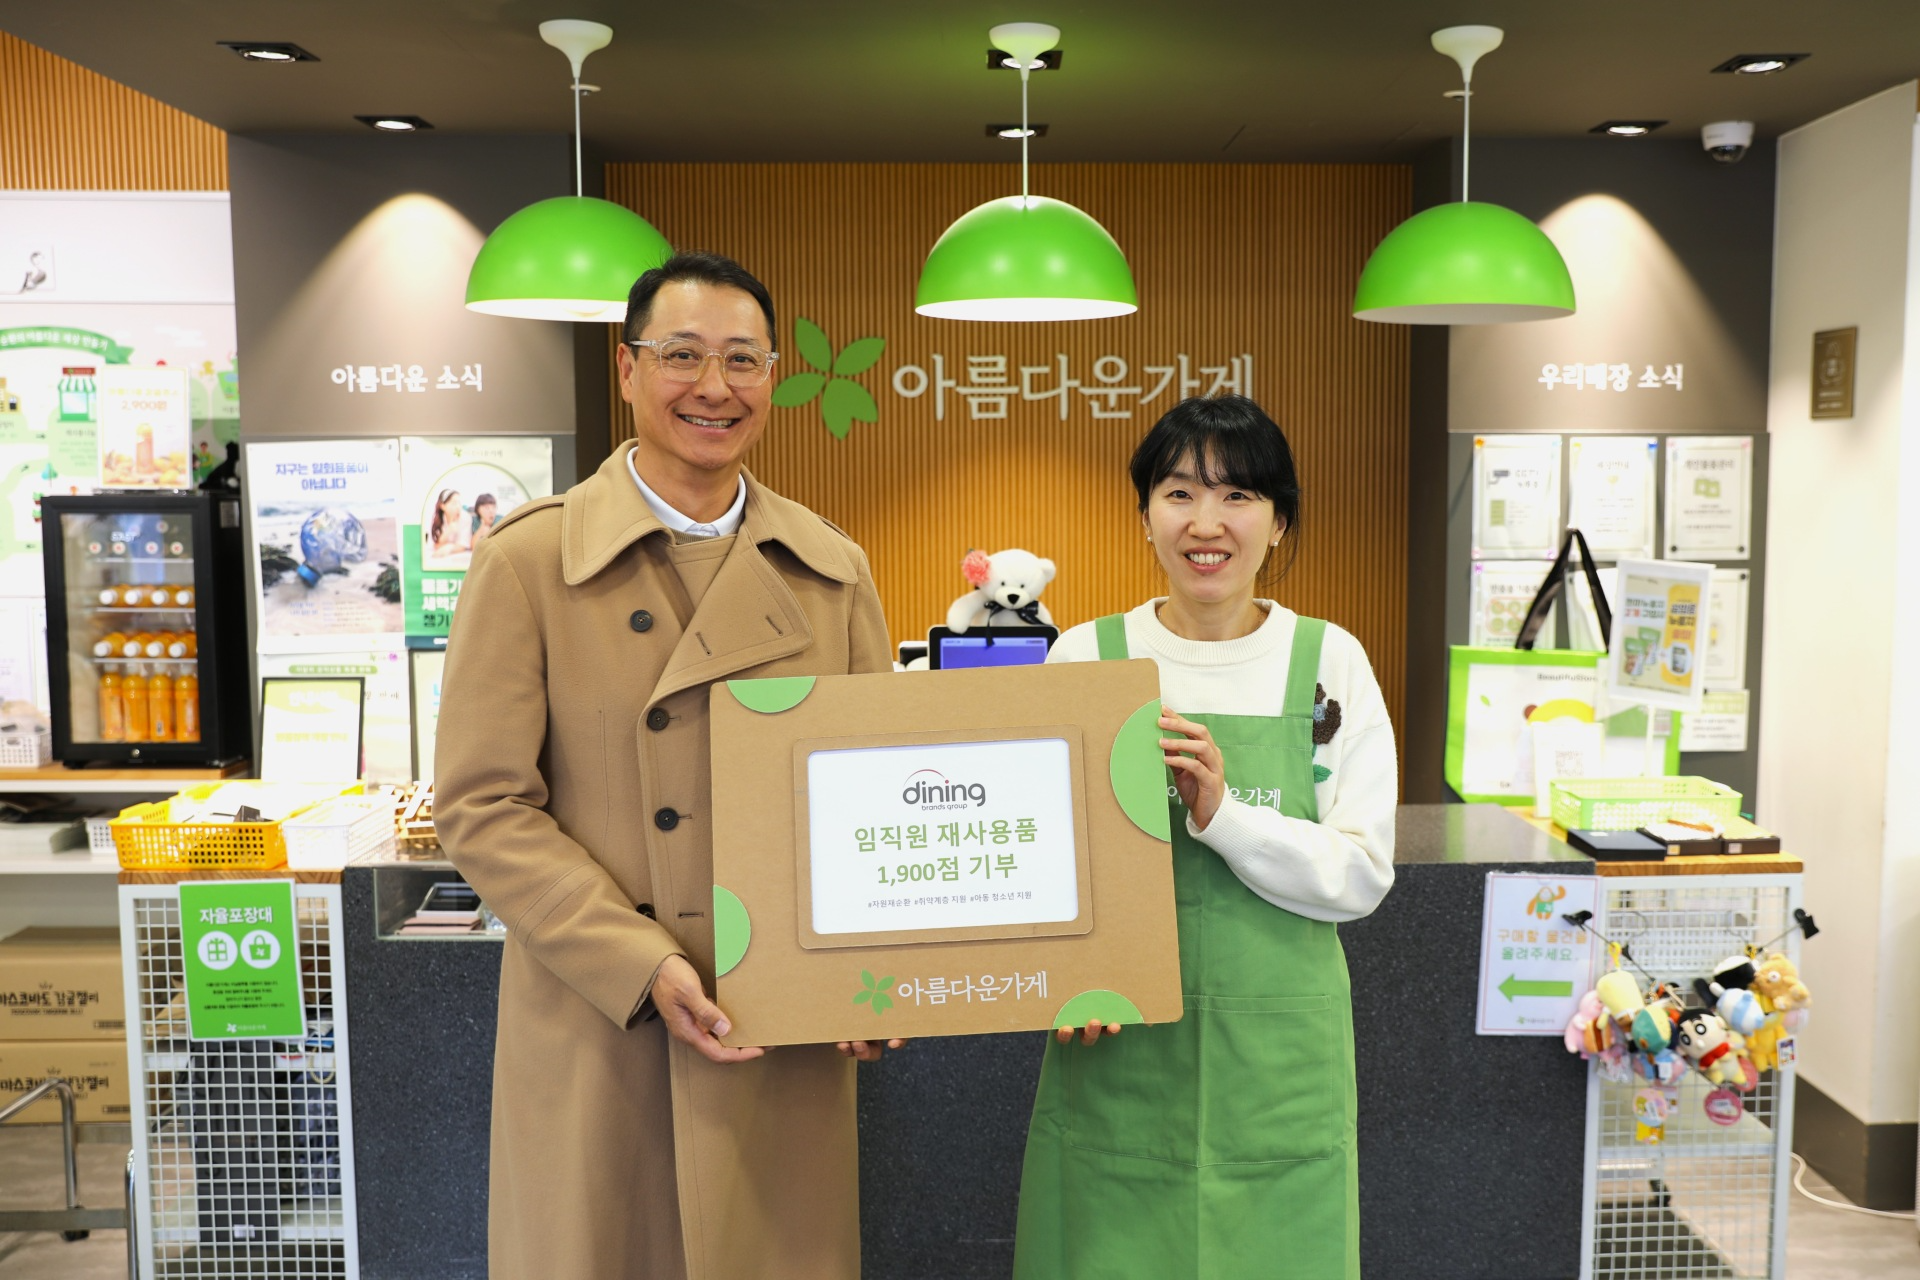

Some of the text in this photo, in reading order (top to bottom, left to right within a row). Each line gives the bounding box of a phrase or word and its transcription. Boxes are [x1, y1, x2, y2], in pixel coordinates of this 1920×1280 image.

[331, 363, 483, 393] 아름다운 소식
[892, 353, 1253, 421] 아름다운가게
[1538, 363, 1684, 392] 우리매장 소식
[902, 779, 986, 807] dining
[947, 803, 968, 811] group
[854, 817, 1038, 852] 임직원 재사용품
[877, 853, 1018, 887] 1,900점 기부
[867, 891, 1033, 909] #자원재순환 #취약계층 지원 #아동 청소년 지원
[199, 906, 273, 925] 자율포장대
[1497, 929, 1539, 943] 구매할
[898, 970, 1048, 1006] 아름다운가게
